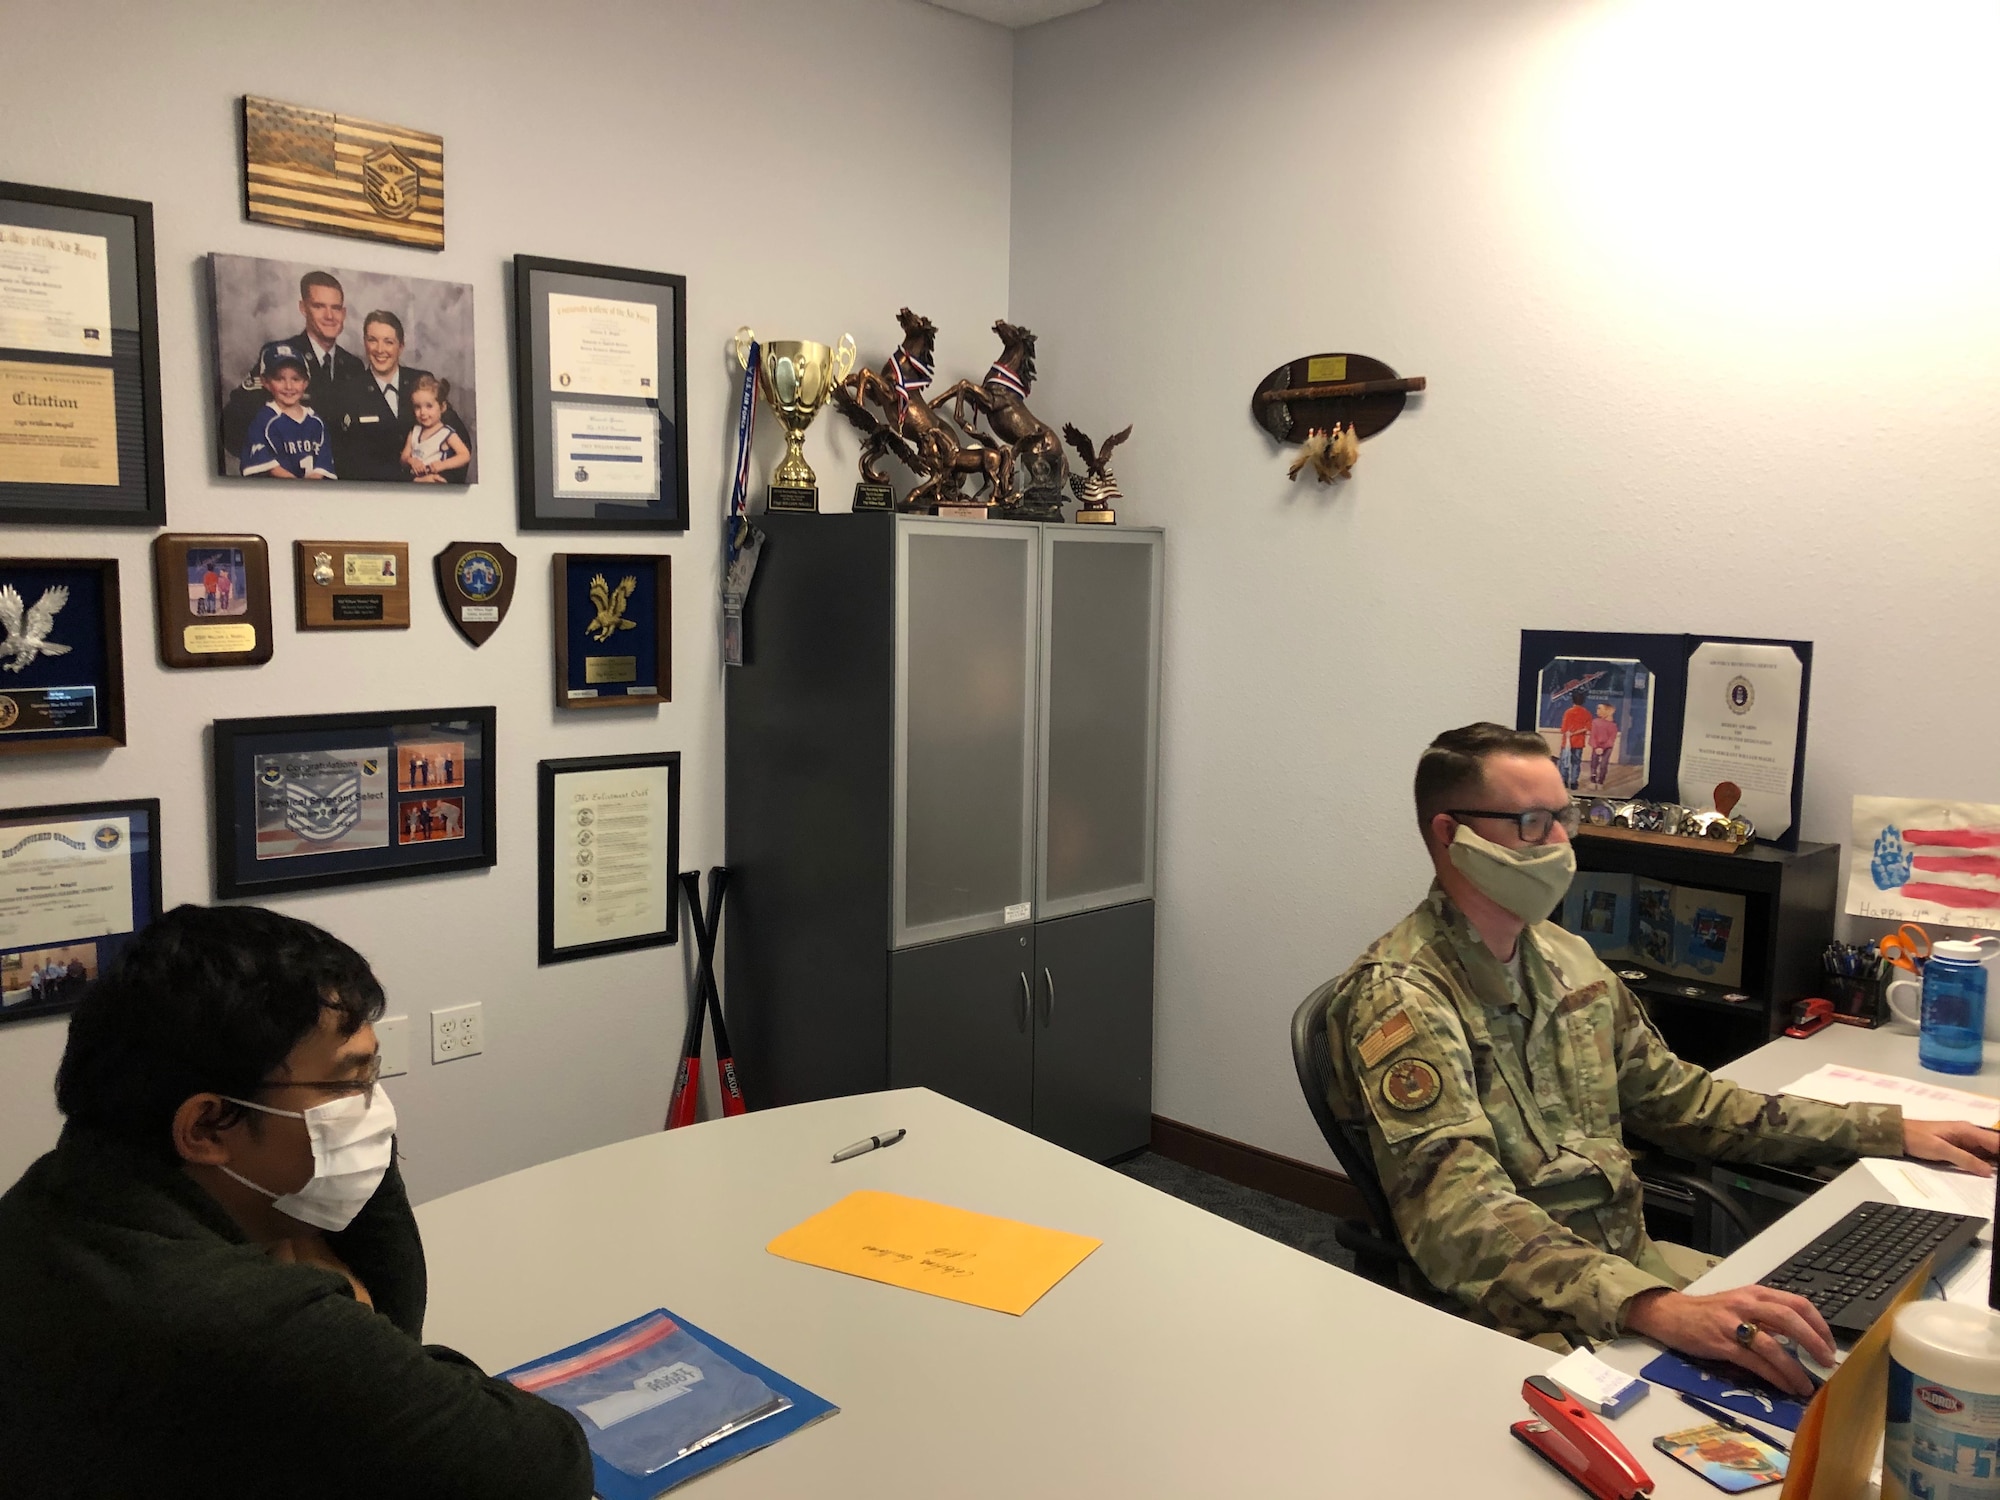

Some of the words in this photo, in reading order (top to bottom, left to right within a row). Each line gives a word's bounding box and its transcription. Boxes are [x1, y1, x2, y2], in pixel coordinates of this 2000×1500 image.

[13, 391, 79, 408] Citation
[286, 760, 358, 773] Congratulations
[260, 797, 308, 808] Technical
[310, 792, 353, 805] Sergeant
[355, 790, 384, 802] Select
[1860, 901, 1903, 921] Happy
[1966, 915, 1996, 929] July
[724, 1062, 740, 1099] HICKORY
[1921, 1389, 1958, 1411] CLOROX
